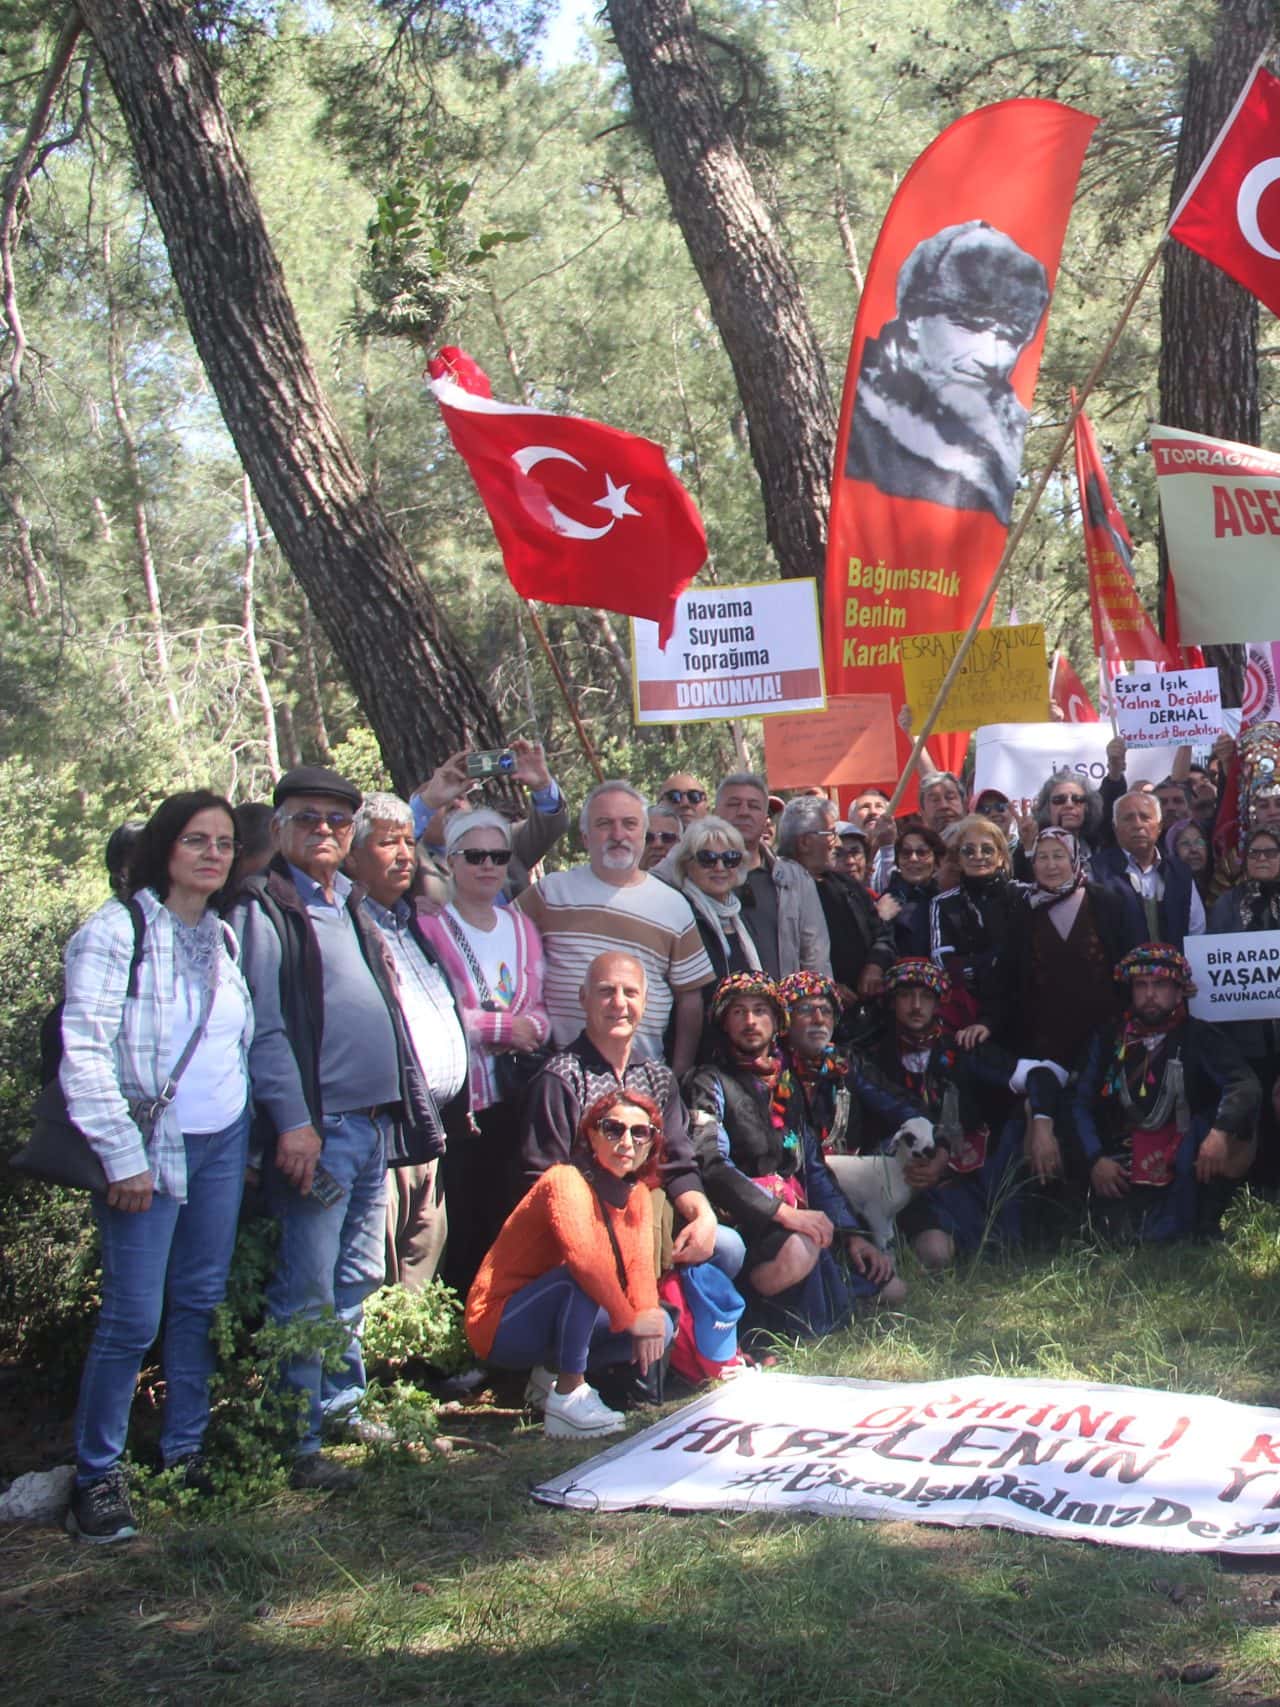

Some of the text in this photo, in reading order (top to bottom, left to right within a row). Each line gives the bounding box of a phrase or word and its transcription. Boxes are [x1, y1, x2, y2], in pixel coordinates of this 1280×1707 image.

[847, 556, 961, 597] Bağımsızlık
[687, 600, 753, 621] Havama
[845, 598, 907, 629] Benim
[689, 625, 755, 647] Suyuma
[683, 648, 770, 672] Toprağıma
[842, 637, 901, 668] Karak
[676, 675, 783, 708] DOKUNMA!
[1115, 675, 1189, 694] Esra Işık
[1117, 695, 1161, 710] Yalnız
[1149, 708, 1209, 724] DERHAL
[1207, 948, 1233, 965] BİR
[853, 1394, 1192, 1450] ORHANLI
